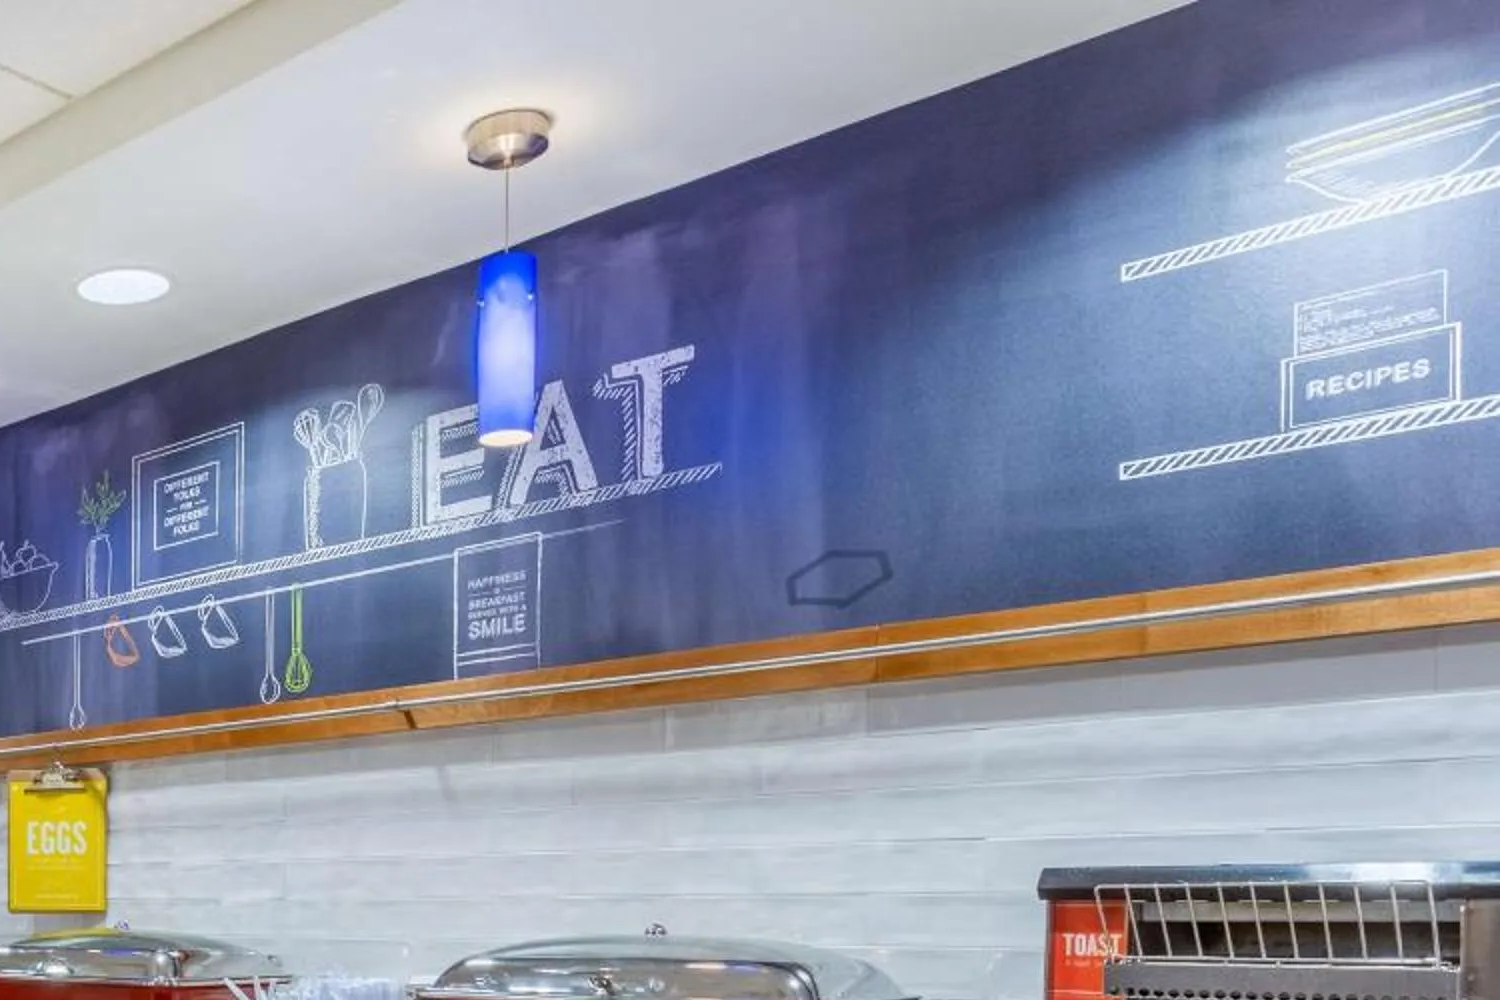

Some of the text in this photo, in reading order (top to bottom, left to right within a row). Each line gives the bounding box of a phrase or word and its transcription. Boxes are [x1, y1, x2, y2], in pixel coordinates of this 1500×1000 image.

[1305, 358, 1431, 401] RECIPES
[413, 345, 695, 526] EAT
[164, 471, 209, 494] DIFFERENT
[467, 570, 527, 590] HAPPINESS
[468, 591, 526, 611] BREAKFAST
[467, 613, 526, 641] SMILE
[26, 820, 89, 857] EGGS
[1061, 932, 1123, 957] TOAST
